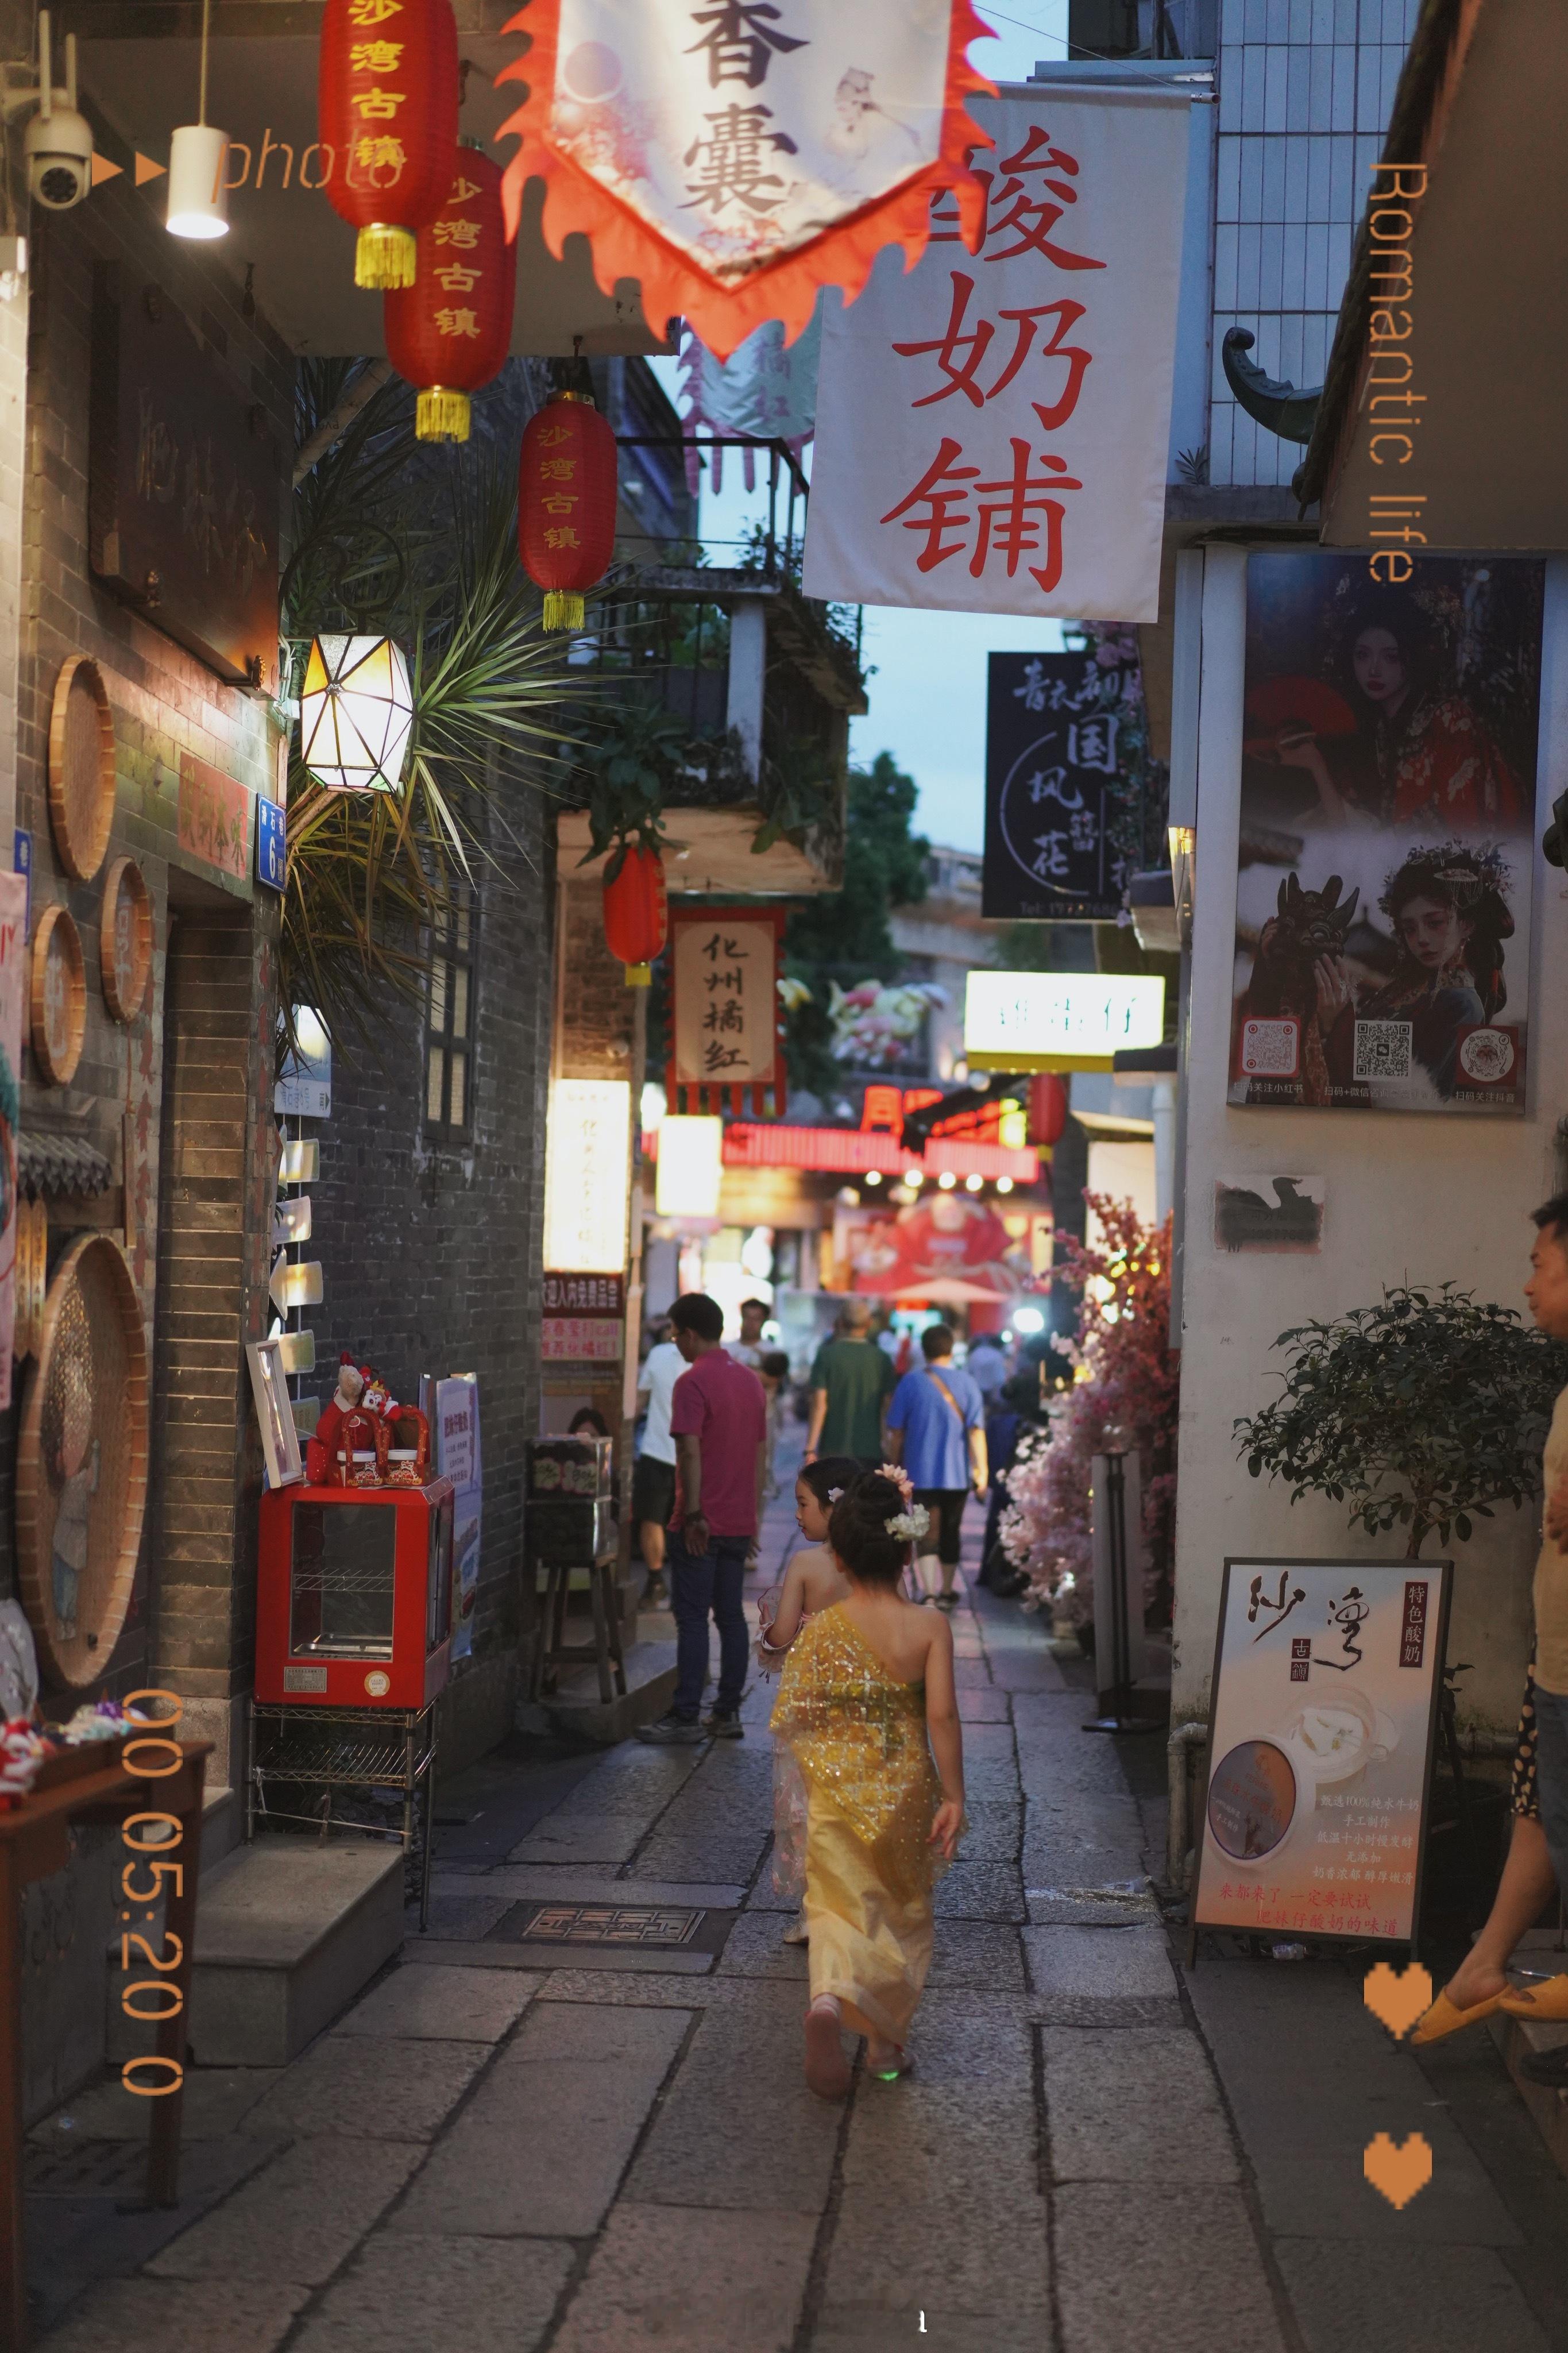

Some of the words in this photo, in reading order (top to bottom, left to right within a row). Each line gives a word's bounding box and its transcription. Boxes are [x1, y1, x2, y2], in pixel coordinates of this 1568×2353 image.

[347, 0, 407, 169] 沙湾古镇
[678, 0, 811, 213] 香囊
[880, 126, 1107, 593] 酸奶铺
[537, 426, 581, 549] 沙湾古镇
[269, 836, 276, 880] 6
[702, 934, 750, 1073] 化州橘红
[1234, 1082, 1303, 1094] 扫码关注小红书
[1456, 1091, 1515, 1104] 扫码关注抖音
[1403, 1586, 1425, 1663] 特色酸奶
[1320, 1794, 1419, 1811] 甄选100%纯水牛奶
[1343, 1814, 1390, 1829] 手工制作
[1317, 1831, 1414, 1849] 低温十小时慢发酵
[1346, 1851, 1381, 1864] 无添加
[1219, 1882, 1280, 1903] 来都来了
[1291, 1889, 1371, 1911] 一定要试试
[1256, 1909, 1399, 1937] 肥妹仔酸奶的味道
